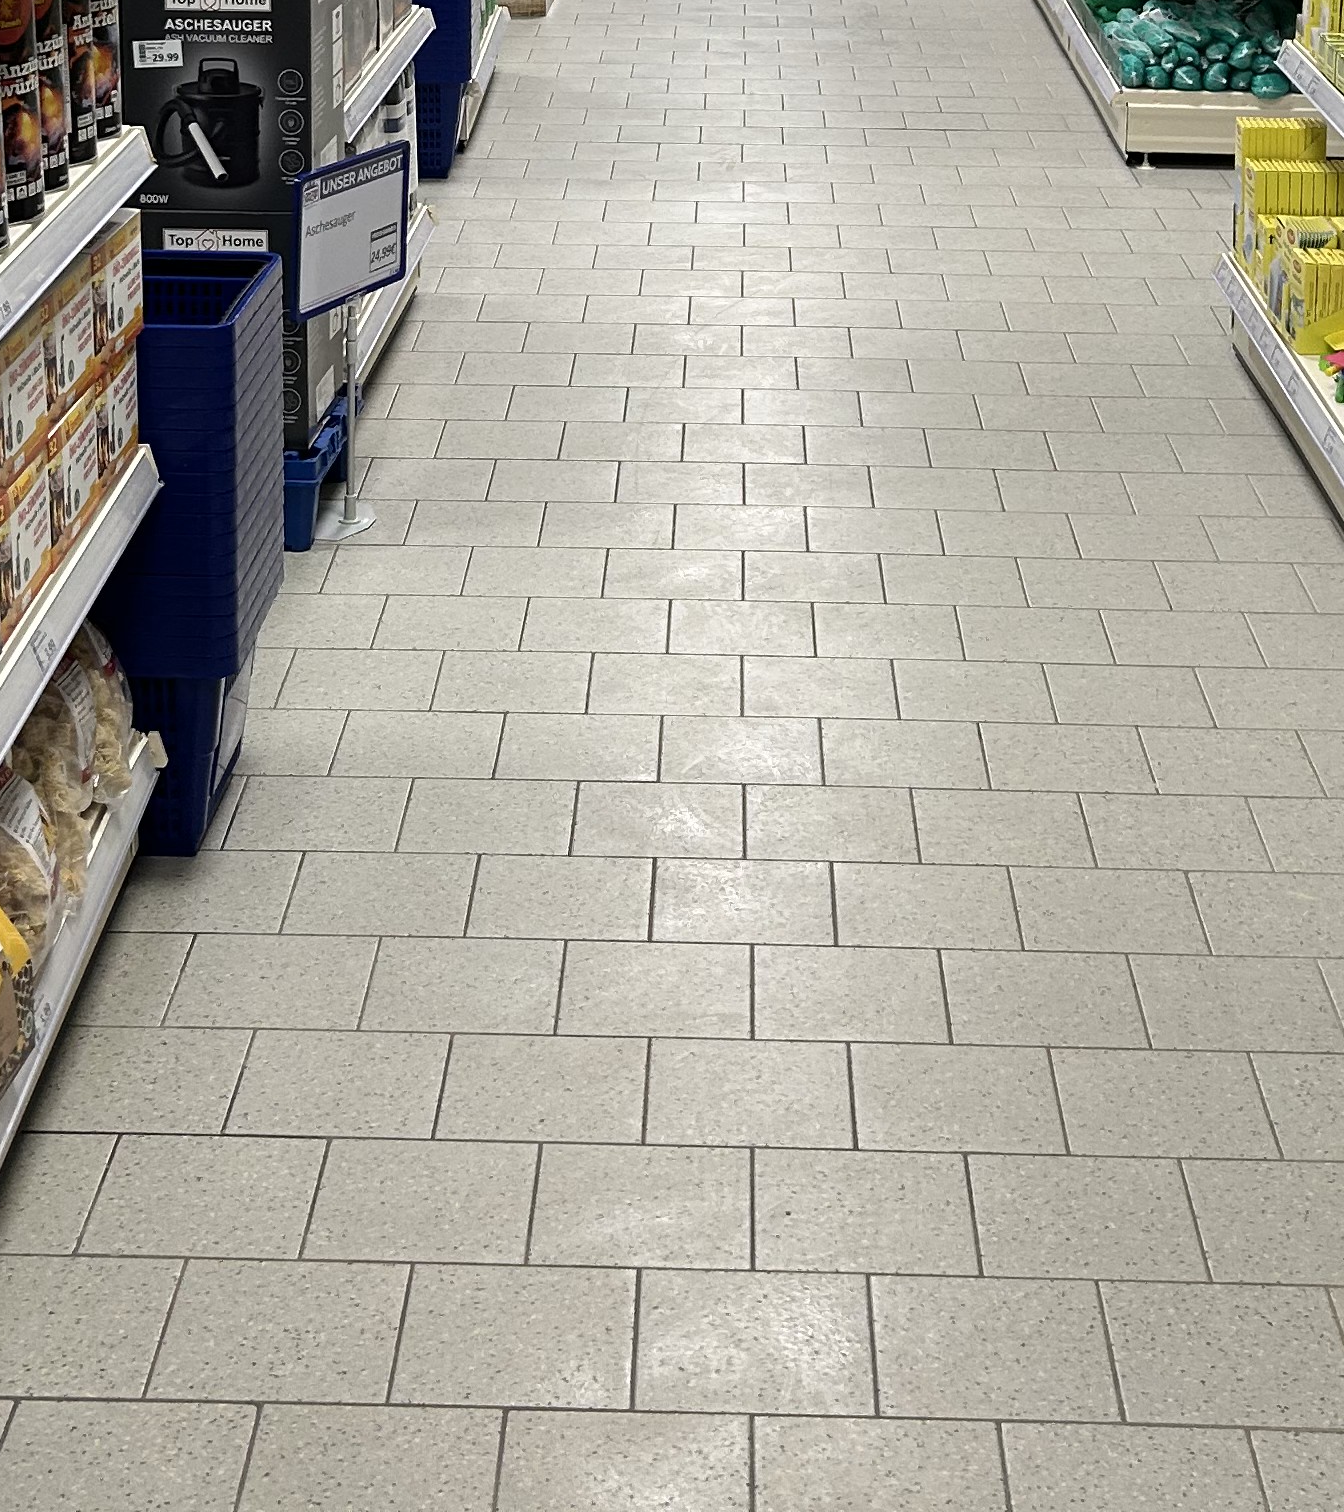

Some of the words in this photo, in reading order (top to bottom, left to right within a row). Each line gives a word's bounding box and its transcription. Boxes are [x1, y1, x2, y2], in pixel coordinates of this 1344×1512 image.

[164, 18, 272, 32] ASCHESAUGER
[186, 33, 227, 43] VACUUM
[228, 34, 273, 44] CLEANER
[152, 52, 179, 62] 29.99
[322, 172, 356, 195] UNSER
[357, 155, 404, 182] ANGEBOT
[140, 194, 169, 204] 800W
[305, 210, 356, 239] Aschesauger
[168, 235, 193, 249] Top
[222, 235, 264, 248] Home
